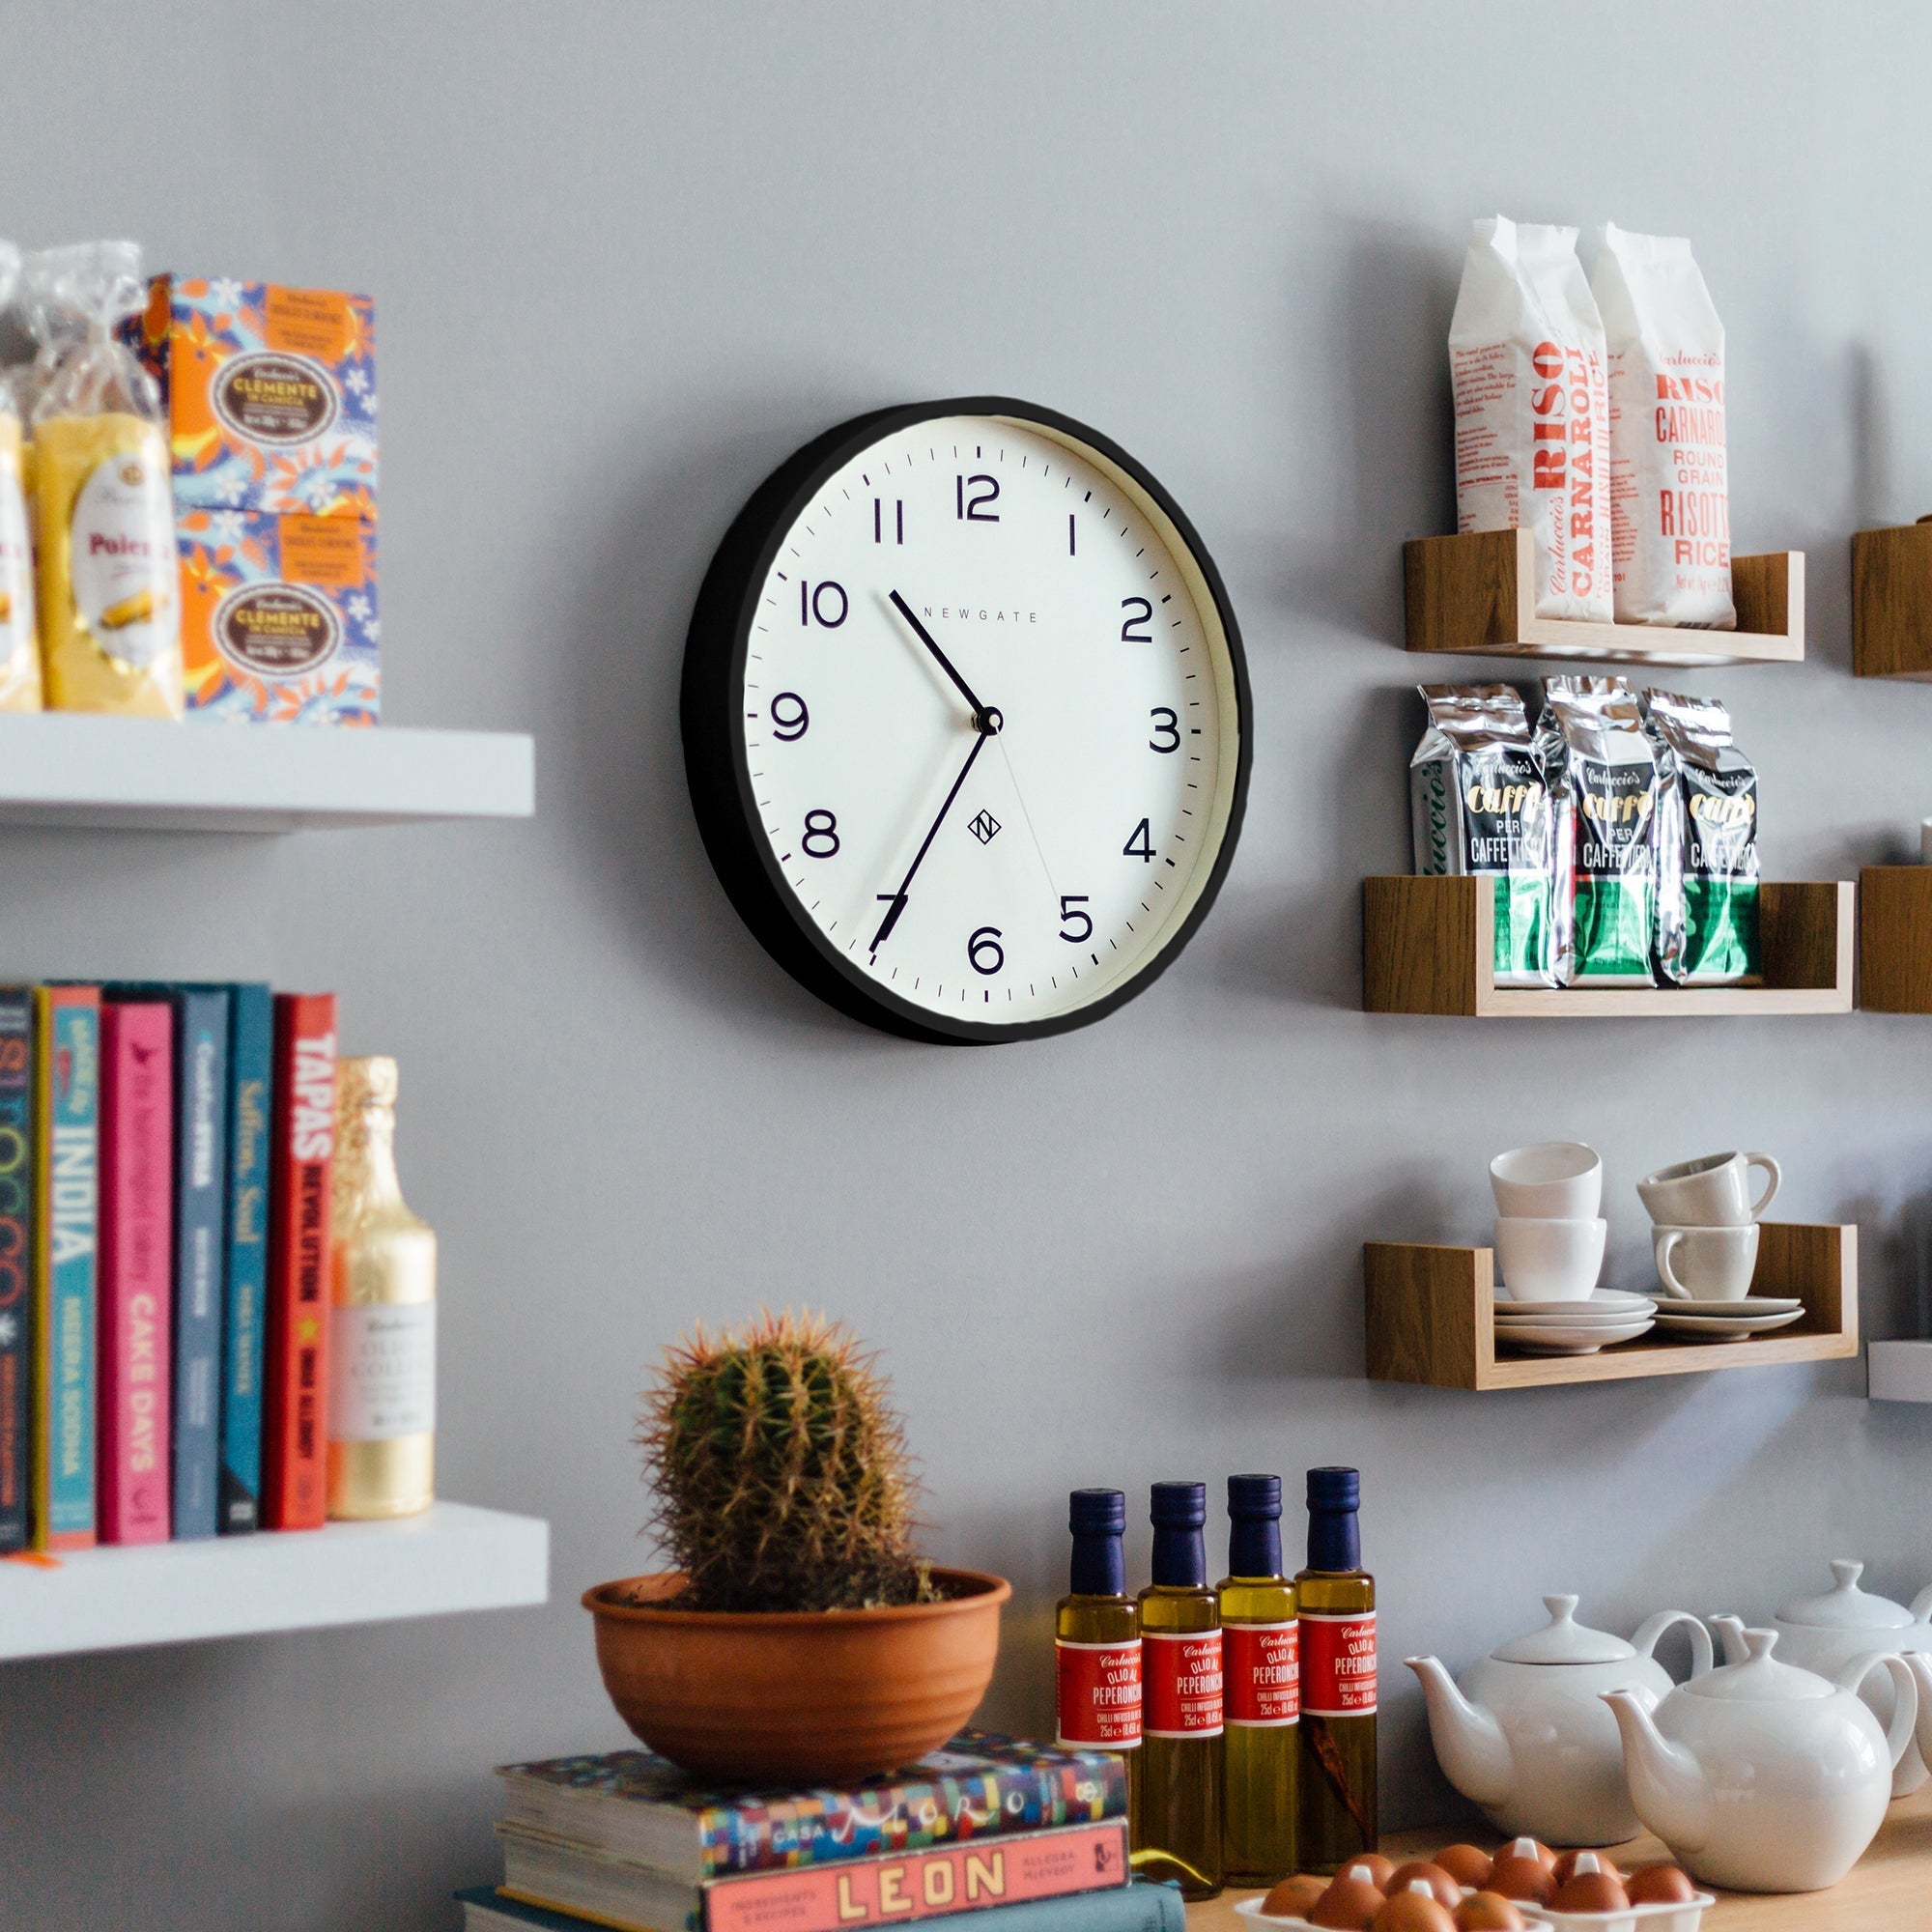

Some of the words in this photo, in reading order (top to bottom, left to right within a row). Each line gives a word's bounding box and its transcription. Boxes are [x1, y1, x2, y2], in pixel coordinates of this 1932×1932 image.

[1657, 349, 1722, 367] arluccio's
[1588, 349, 1607, 421] RICE
[1655, 373, 1725, 406] RISO
[1531, 341, 1567, 491] RISO
[1655, 406, 1726, 448] CARNARO
[1565, 345, 1594, 598] CARNAROLI
[1678, 469, 1723, 487] GRAIN
[873, 497, 904, 545] 11
[954, 474, 1001, 523] 12
[1068, 514, 1076, 556] 1
[1546, 495, 1567, 596] Carluccio's
[1674, 539, 1729, 568] RICE
[800, 580, 849, 629] 10
[923, 607, 1037, 623] NEWGATE
[1121, 596, 1154, 644] 2
[770, 692, 810, 742] 9
[1149, 706, 1181, 754] 3
[801, 809, 841, 859] 8
[1122, 817, 1157, 864] 4
[1496, 820, 1520, 834] PER
[1610, 828, 1634, 841] PER
[875, 894, 909, 942] 7
[1059, 895, 1094, 944] 5
[967, 926, 1005, 976] 6
[293, 1033, 335, 1161] TAPAS
[51, 1124, 97, 1265] INDIA
[298, 1164, 323, 1302] REVOLUTION
[129, 1293, 156, 1384] CAKE
[129, 1389, 156, 1473] DAYS
[1190, 1658, 1210, 1674] OLIO
[1266, 1648, 1287, 1664] OLIO
[1348, 1639, 1367, 1656] OLIO
[1107, 1668, 1128, 1685] OLIO
[773, 1824, 825, 1844] CASA
[837, 1849, 1006, 1920] LEON
